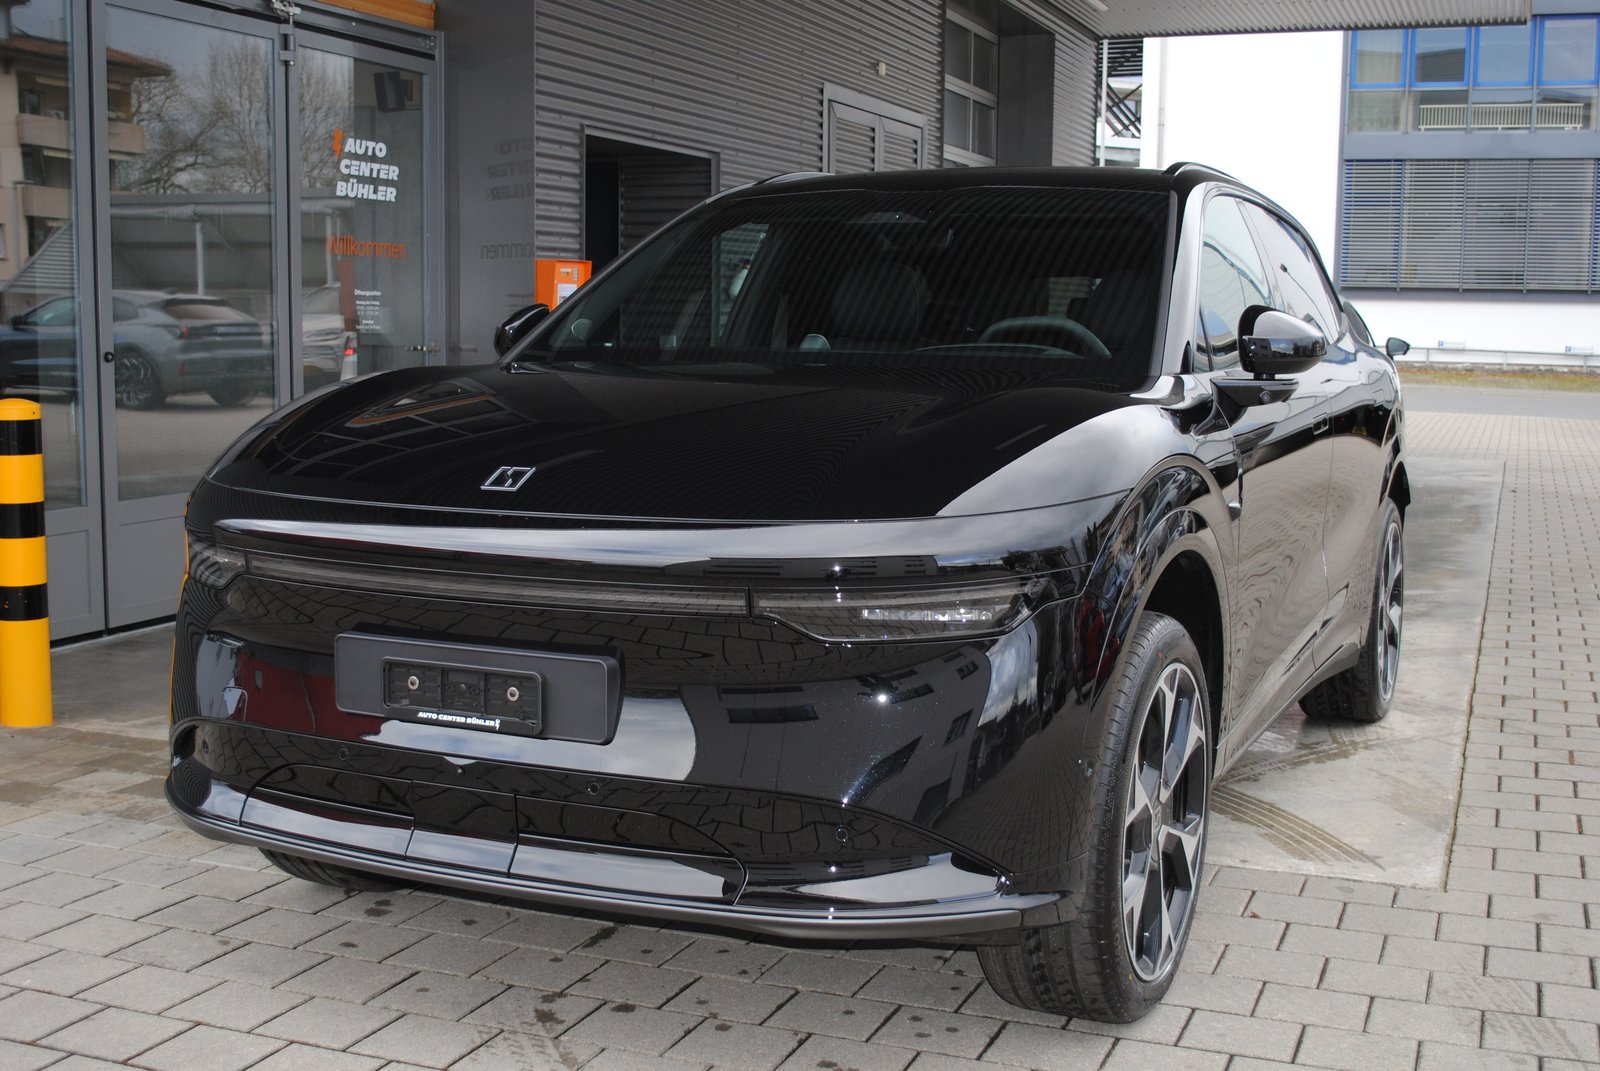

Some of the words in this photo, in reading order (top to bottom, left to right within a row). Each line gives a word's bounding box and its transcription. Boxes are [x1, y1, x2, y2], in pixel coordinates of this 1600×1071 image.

[345, 138, 387, 158] AUTO
[340, 158, 399, 180] CENTER
[336, 178, 397, 202] BÜHLER
[325, 234, 407, 258] Willkommen
[417, 711, 438, 720] AUTO
[438, 714, 466, 723] CENTER
[466, 717, 496, 727] BÜHLER
